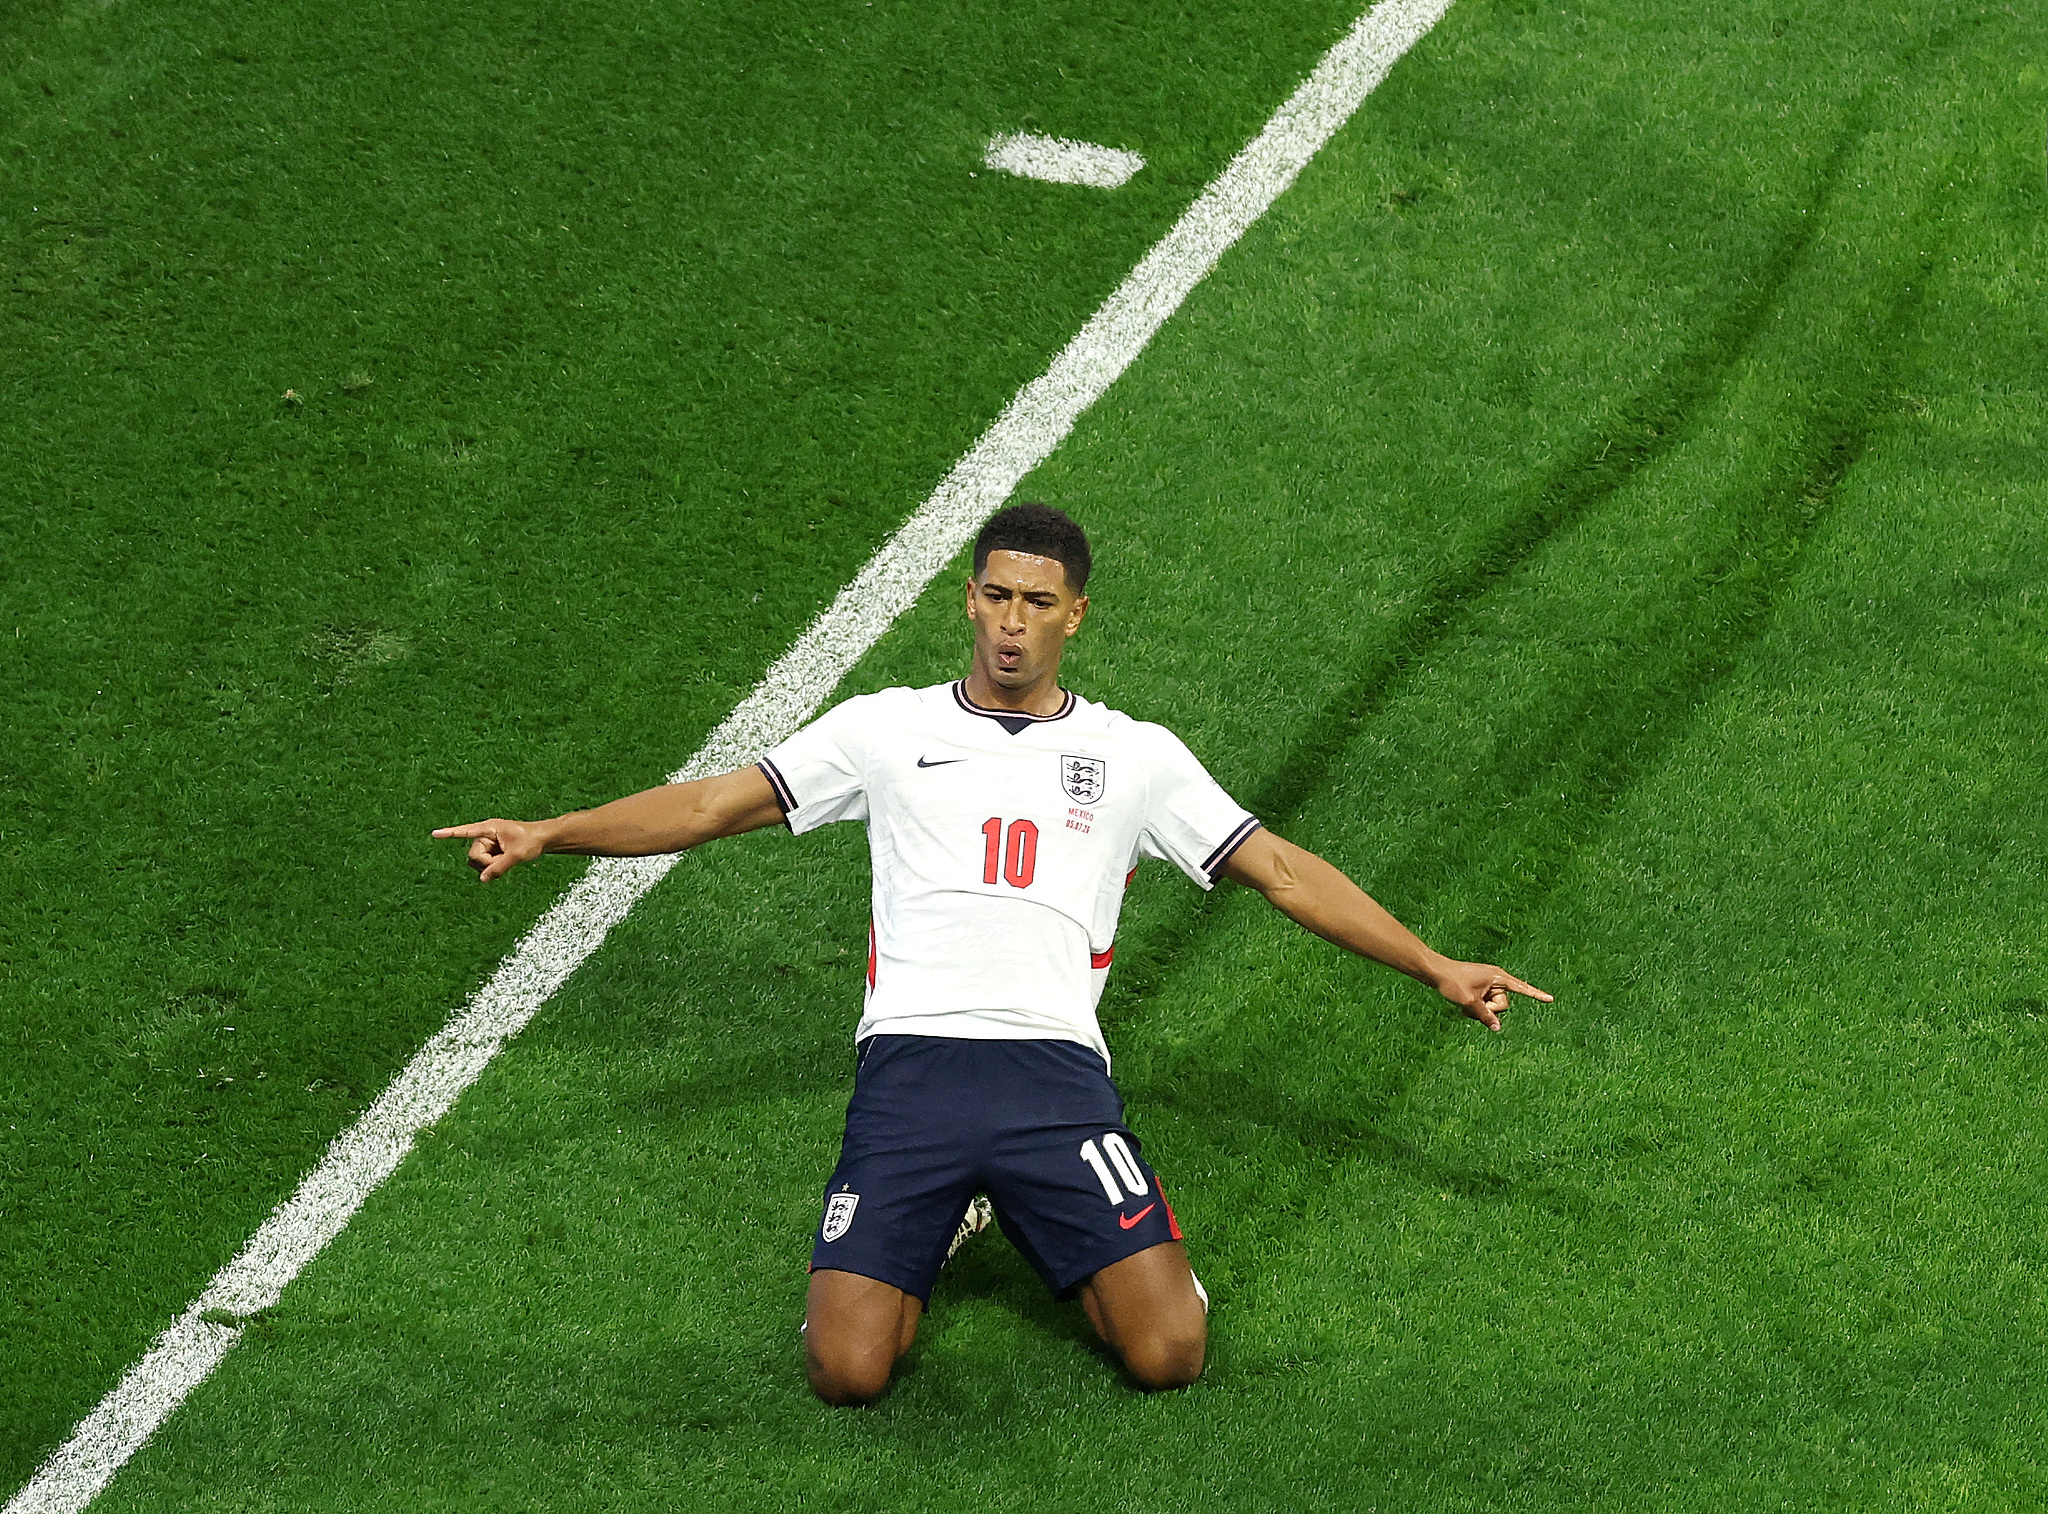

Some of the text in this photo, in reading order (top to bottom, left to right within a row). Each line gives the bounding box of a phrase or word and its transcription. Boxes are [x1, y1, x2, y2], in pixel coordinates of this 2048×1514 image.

[1068, 807, 1094, 822] MEXICO
[982, 816, 1039, 889] 10
[1080, 1132, 1149, 1206] 10
